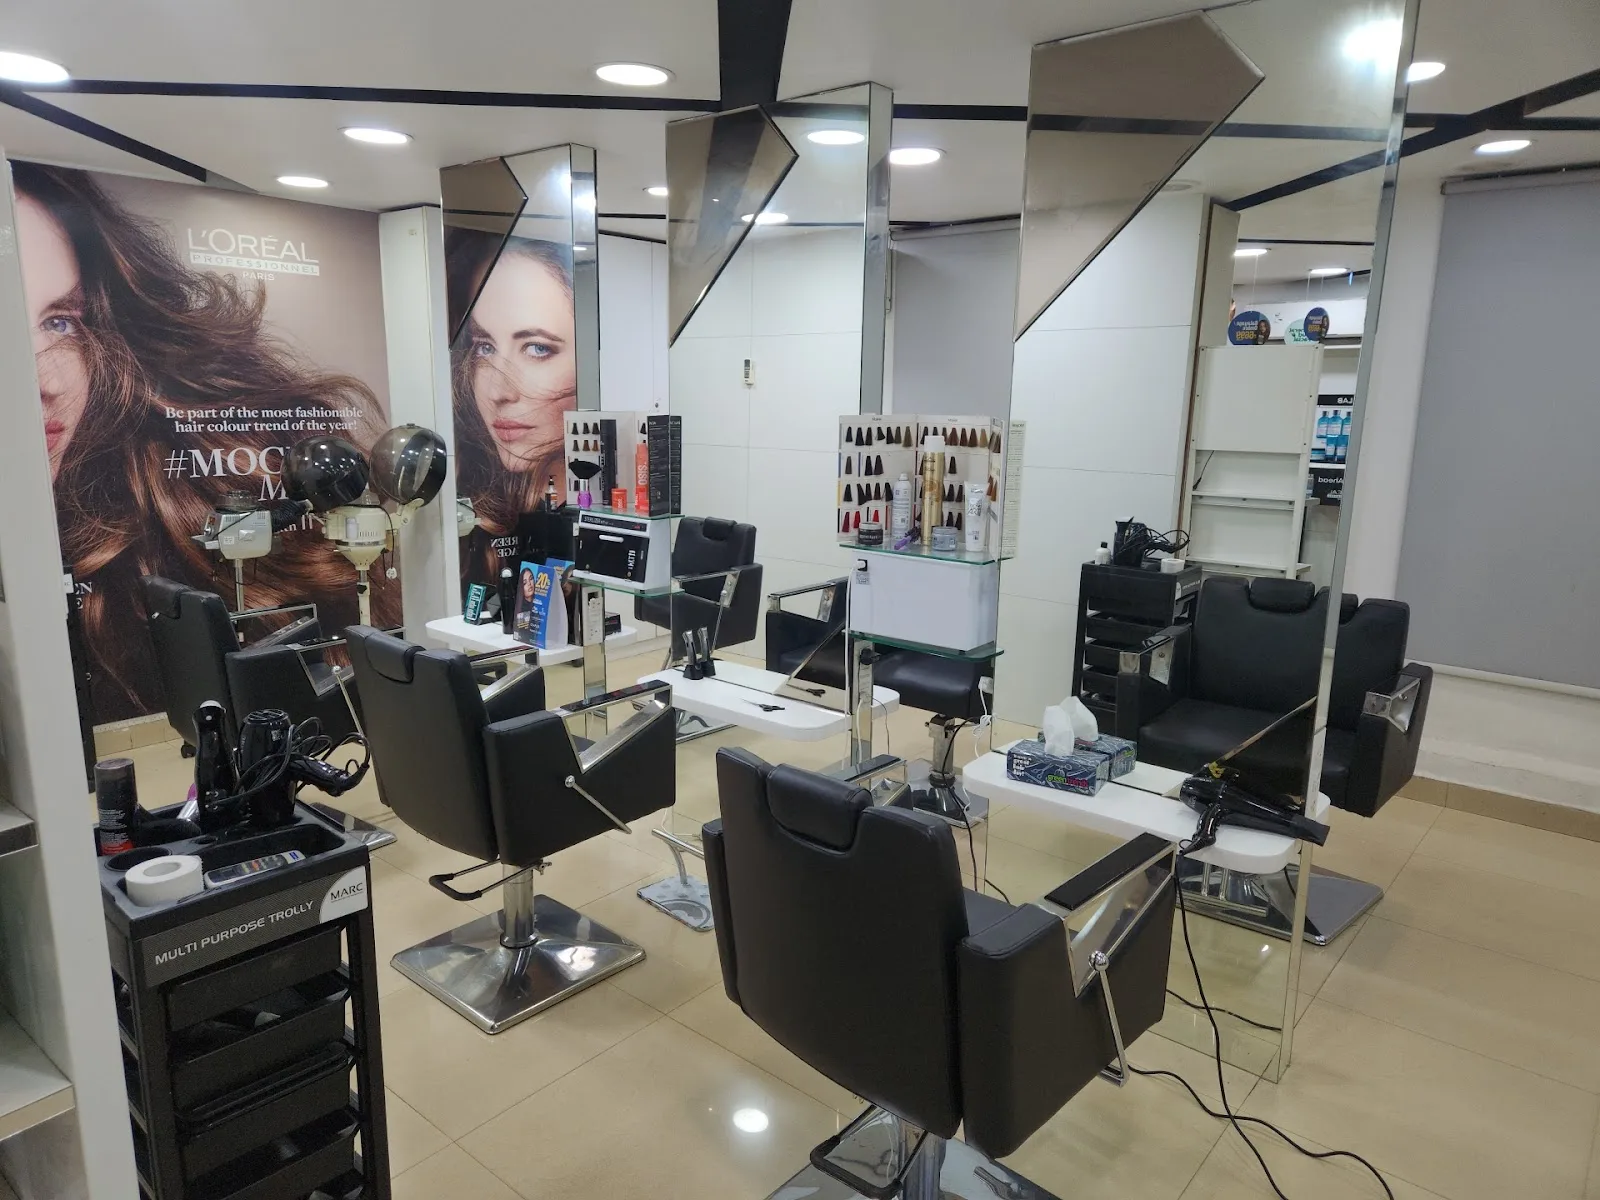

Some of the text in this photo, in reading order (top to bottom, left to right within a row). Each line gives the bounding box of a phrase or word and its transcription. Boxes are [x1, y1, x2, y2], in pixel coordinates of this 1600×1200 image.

[188, 228, 319, 263] L'ORÉAL
[192, 254, 318, 274] PROFESSIONNEL
[243, 271, 275, 281] PARIS
[165, 406, 363, 422] Be part of the most fashionable
[175, 420, 357, 434] hair colour trend of the year!
[163, 446, 290, 479] #MOC
[330, 882, 364, 900] MARC
[154, 899, 315, 966] MULTI PURPOSE TROLLY
